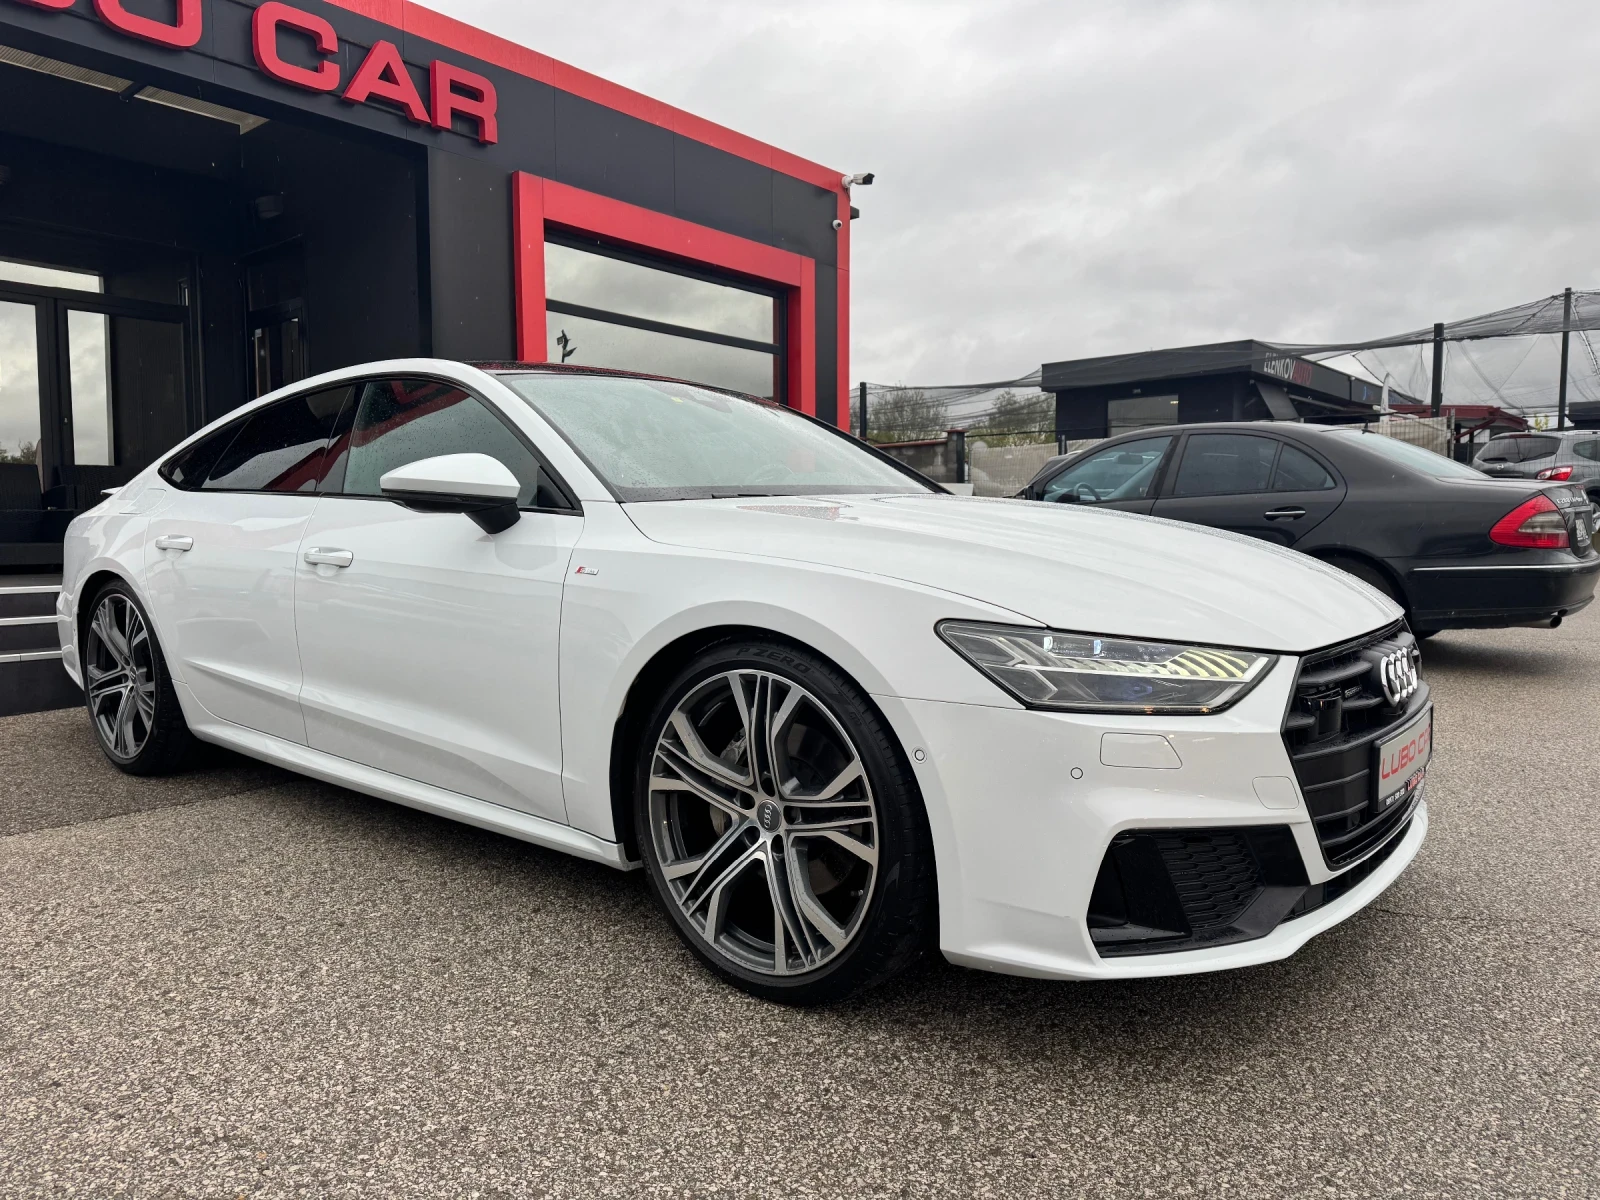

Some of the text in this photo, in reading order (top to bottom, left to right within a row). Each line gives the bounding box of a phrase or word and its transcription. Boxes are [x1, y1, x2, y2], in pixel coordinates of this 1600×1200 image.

[252, 0, 498, 145] CAR
[736, 647, 811, 673] P ZERO
[1381, 739, 1416, 780] LUBO
